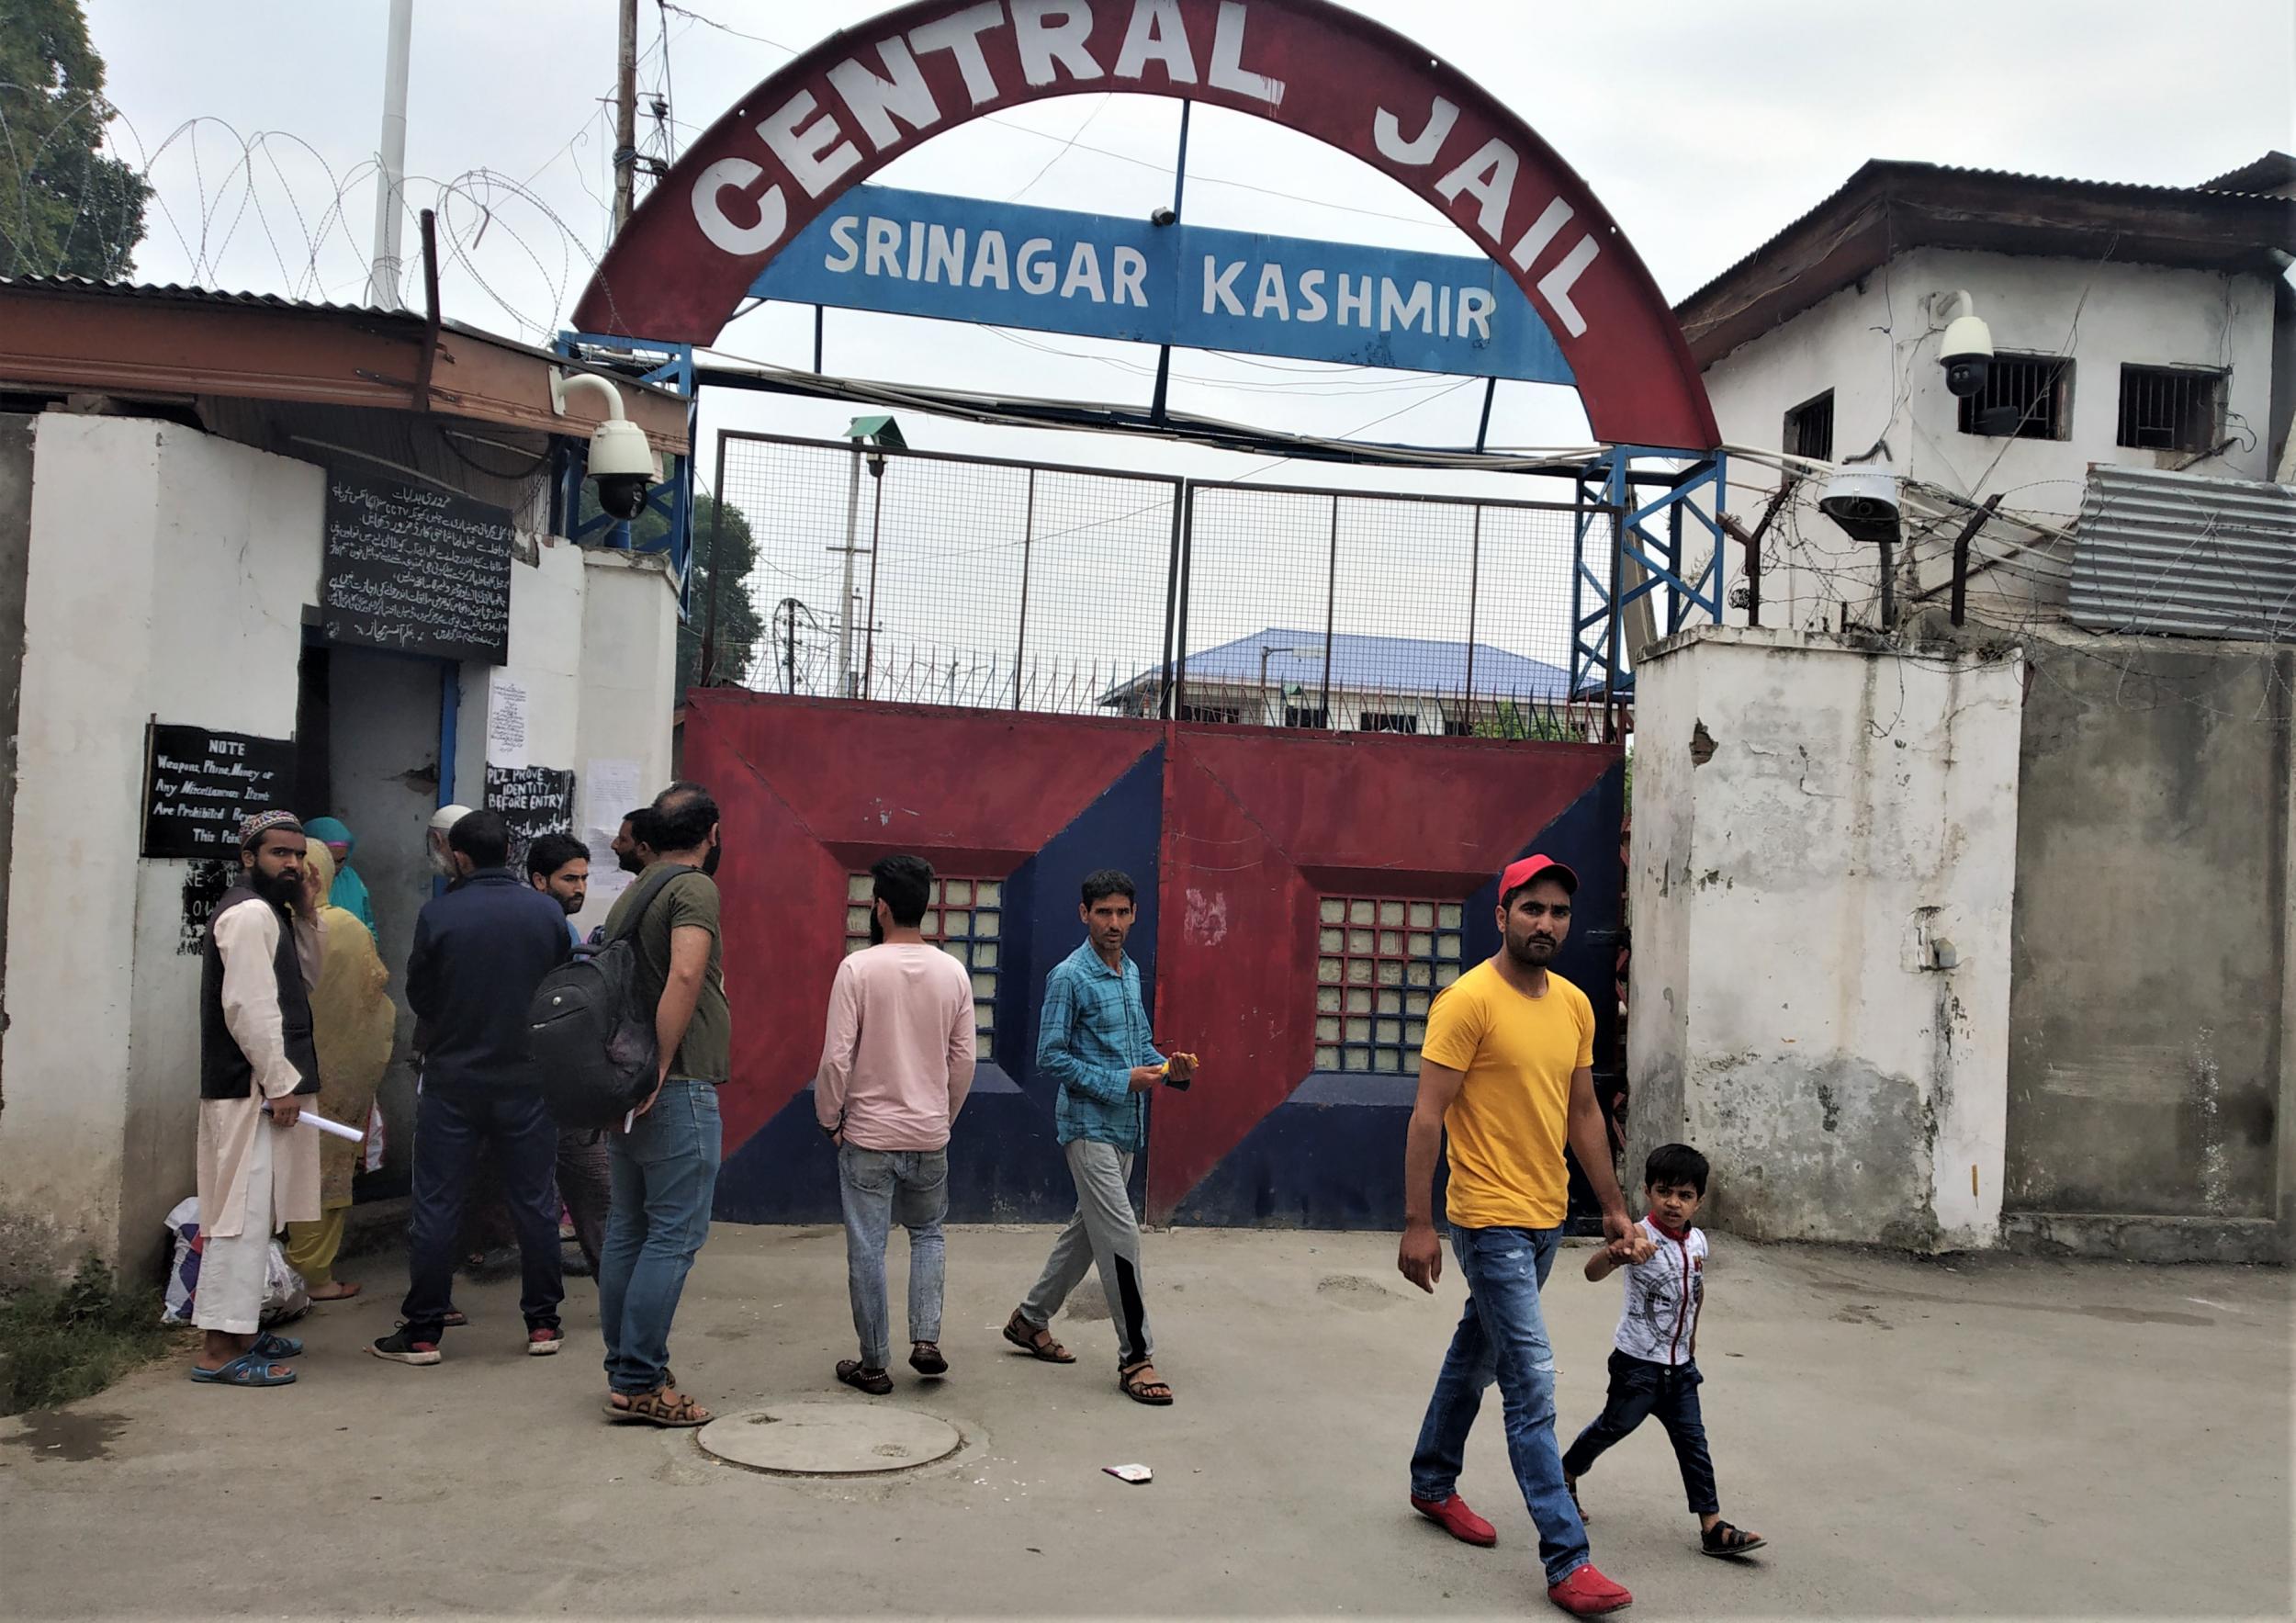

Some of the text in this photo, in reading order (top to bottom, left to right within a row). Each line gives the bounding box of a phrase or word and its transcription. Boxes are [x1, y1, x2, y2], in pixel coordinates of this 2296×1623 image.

[692, 0, 1600, 339] CENTRAL JAIL
[827, 216, 1496, 340] SRINAGAR KASHMIR
[385, 504, 409, 515] CCTV
[208, 739, 246, 755] NOTE
[262, 771, 274, 780] or
[512, 768, 545, 783] PROVE
[155, 778, 178, 797] Any
[503, 782, 551, 796] IDENTITY
[488, 793, 564, 810] BEFORE ENTRY
[153, 802, 174, 815] Are
[177, 803, 225, 819] Prohibited
[193, 828, 242, 844] This Poin
